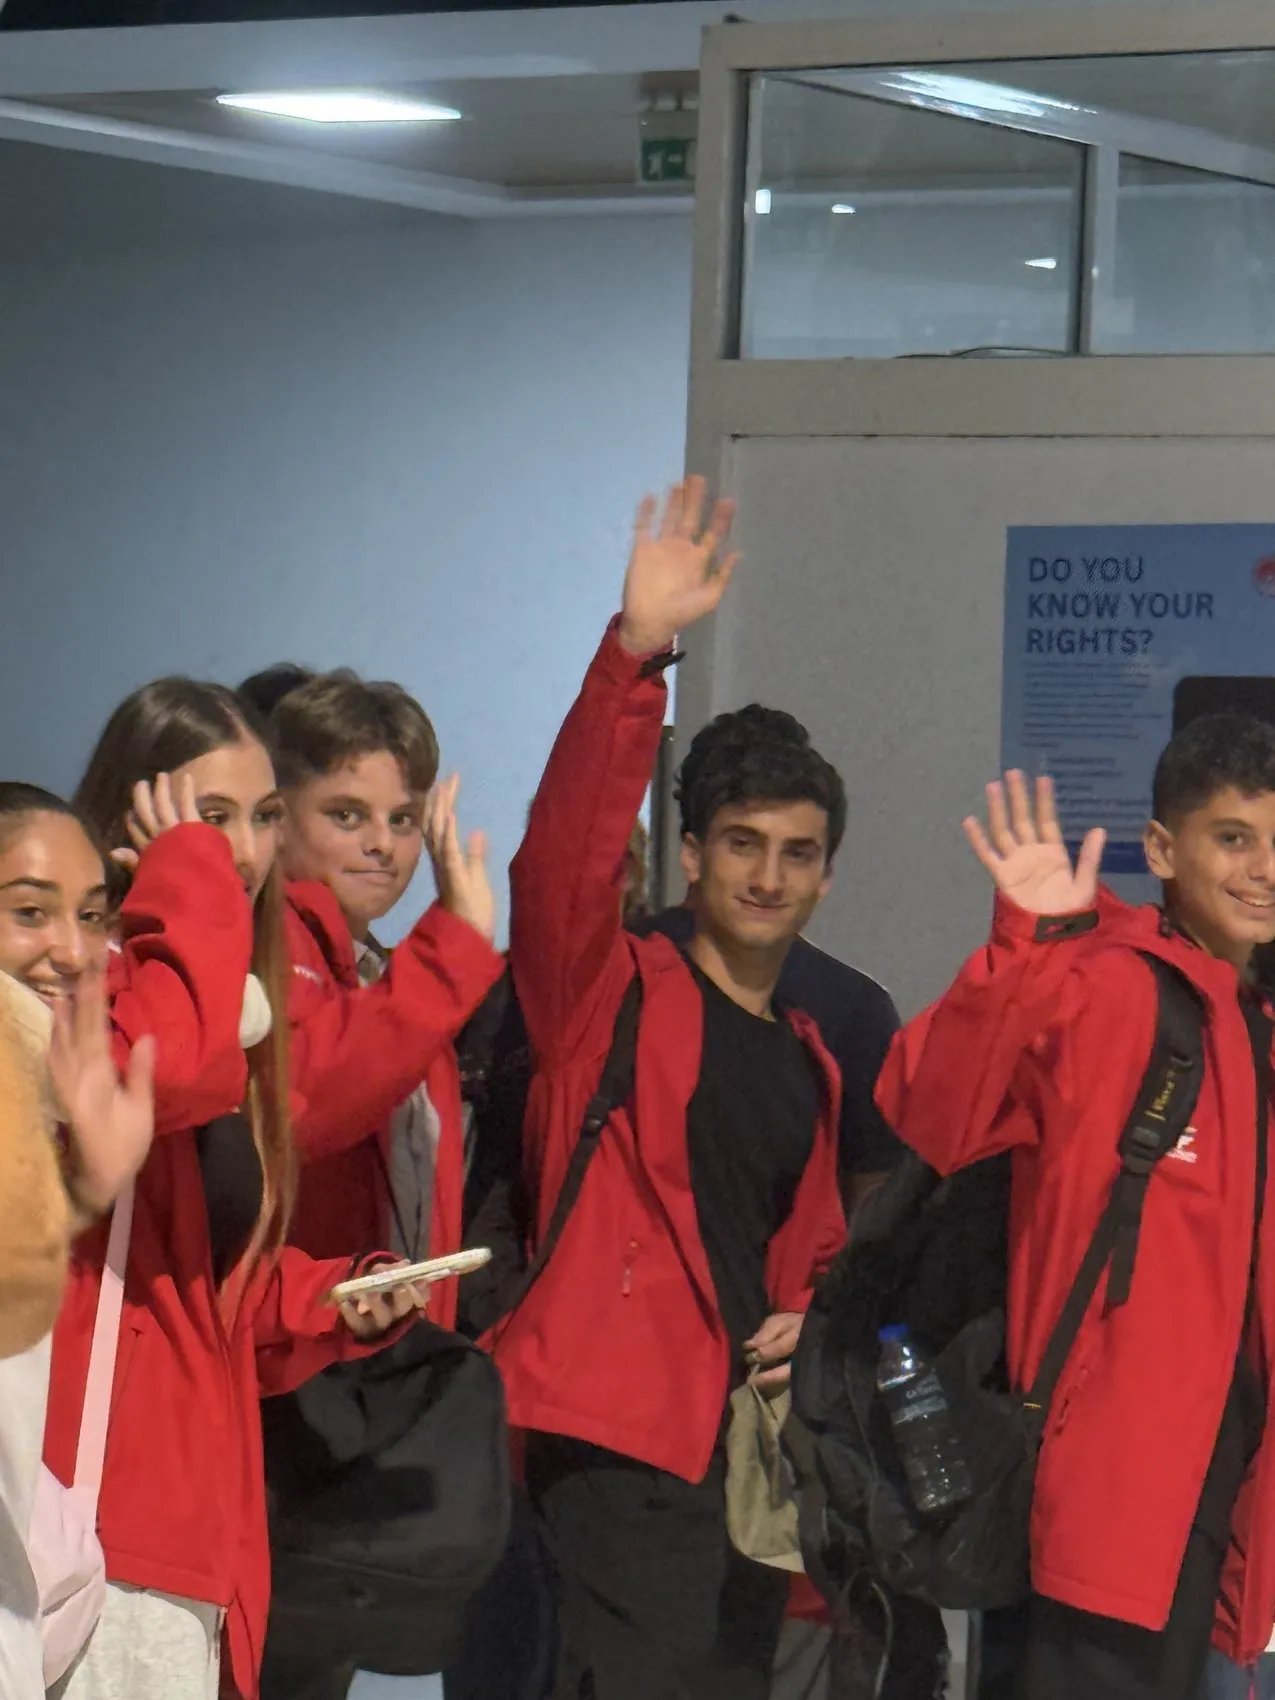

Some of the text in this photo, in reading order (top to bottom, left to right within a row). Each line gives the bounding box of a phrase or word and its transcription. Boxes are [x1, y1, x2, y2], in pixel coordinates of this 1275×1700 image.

[1029, 556, 1143, 583] DO YOU
[1027, 592, 1214, 619] KNOW YOUR
[1027, 628, 1154, 655] RIGHTS?
